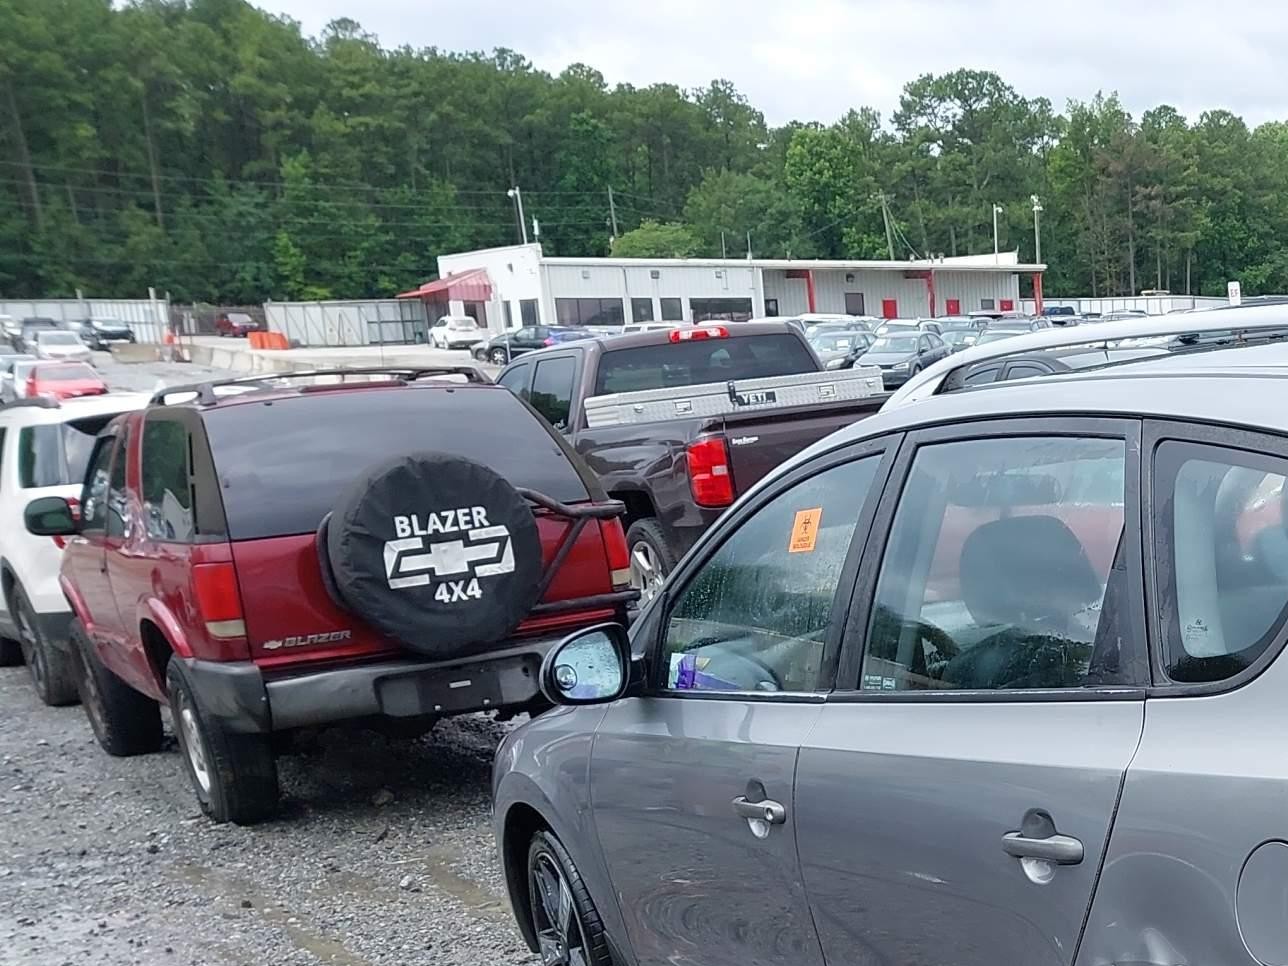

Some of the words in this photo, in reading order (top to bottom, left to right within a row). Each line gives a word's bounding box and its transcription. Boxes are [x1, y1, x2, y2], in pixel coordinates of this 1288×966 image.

[741, 391, 767, 404] YETI
[394, 506, 490, 538] BLAZER
[434, 578, 483, 603] 4X4
[284, 629, 352, 648] BLAZER
